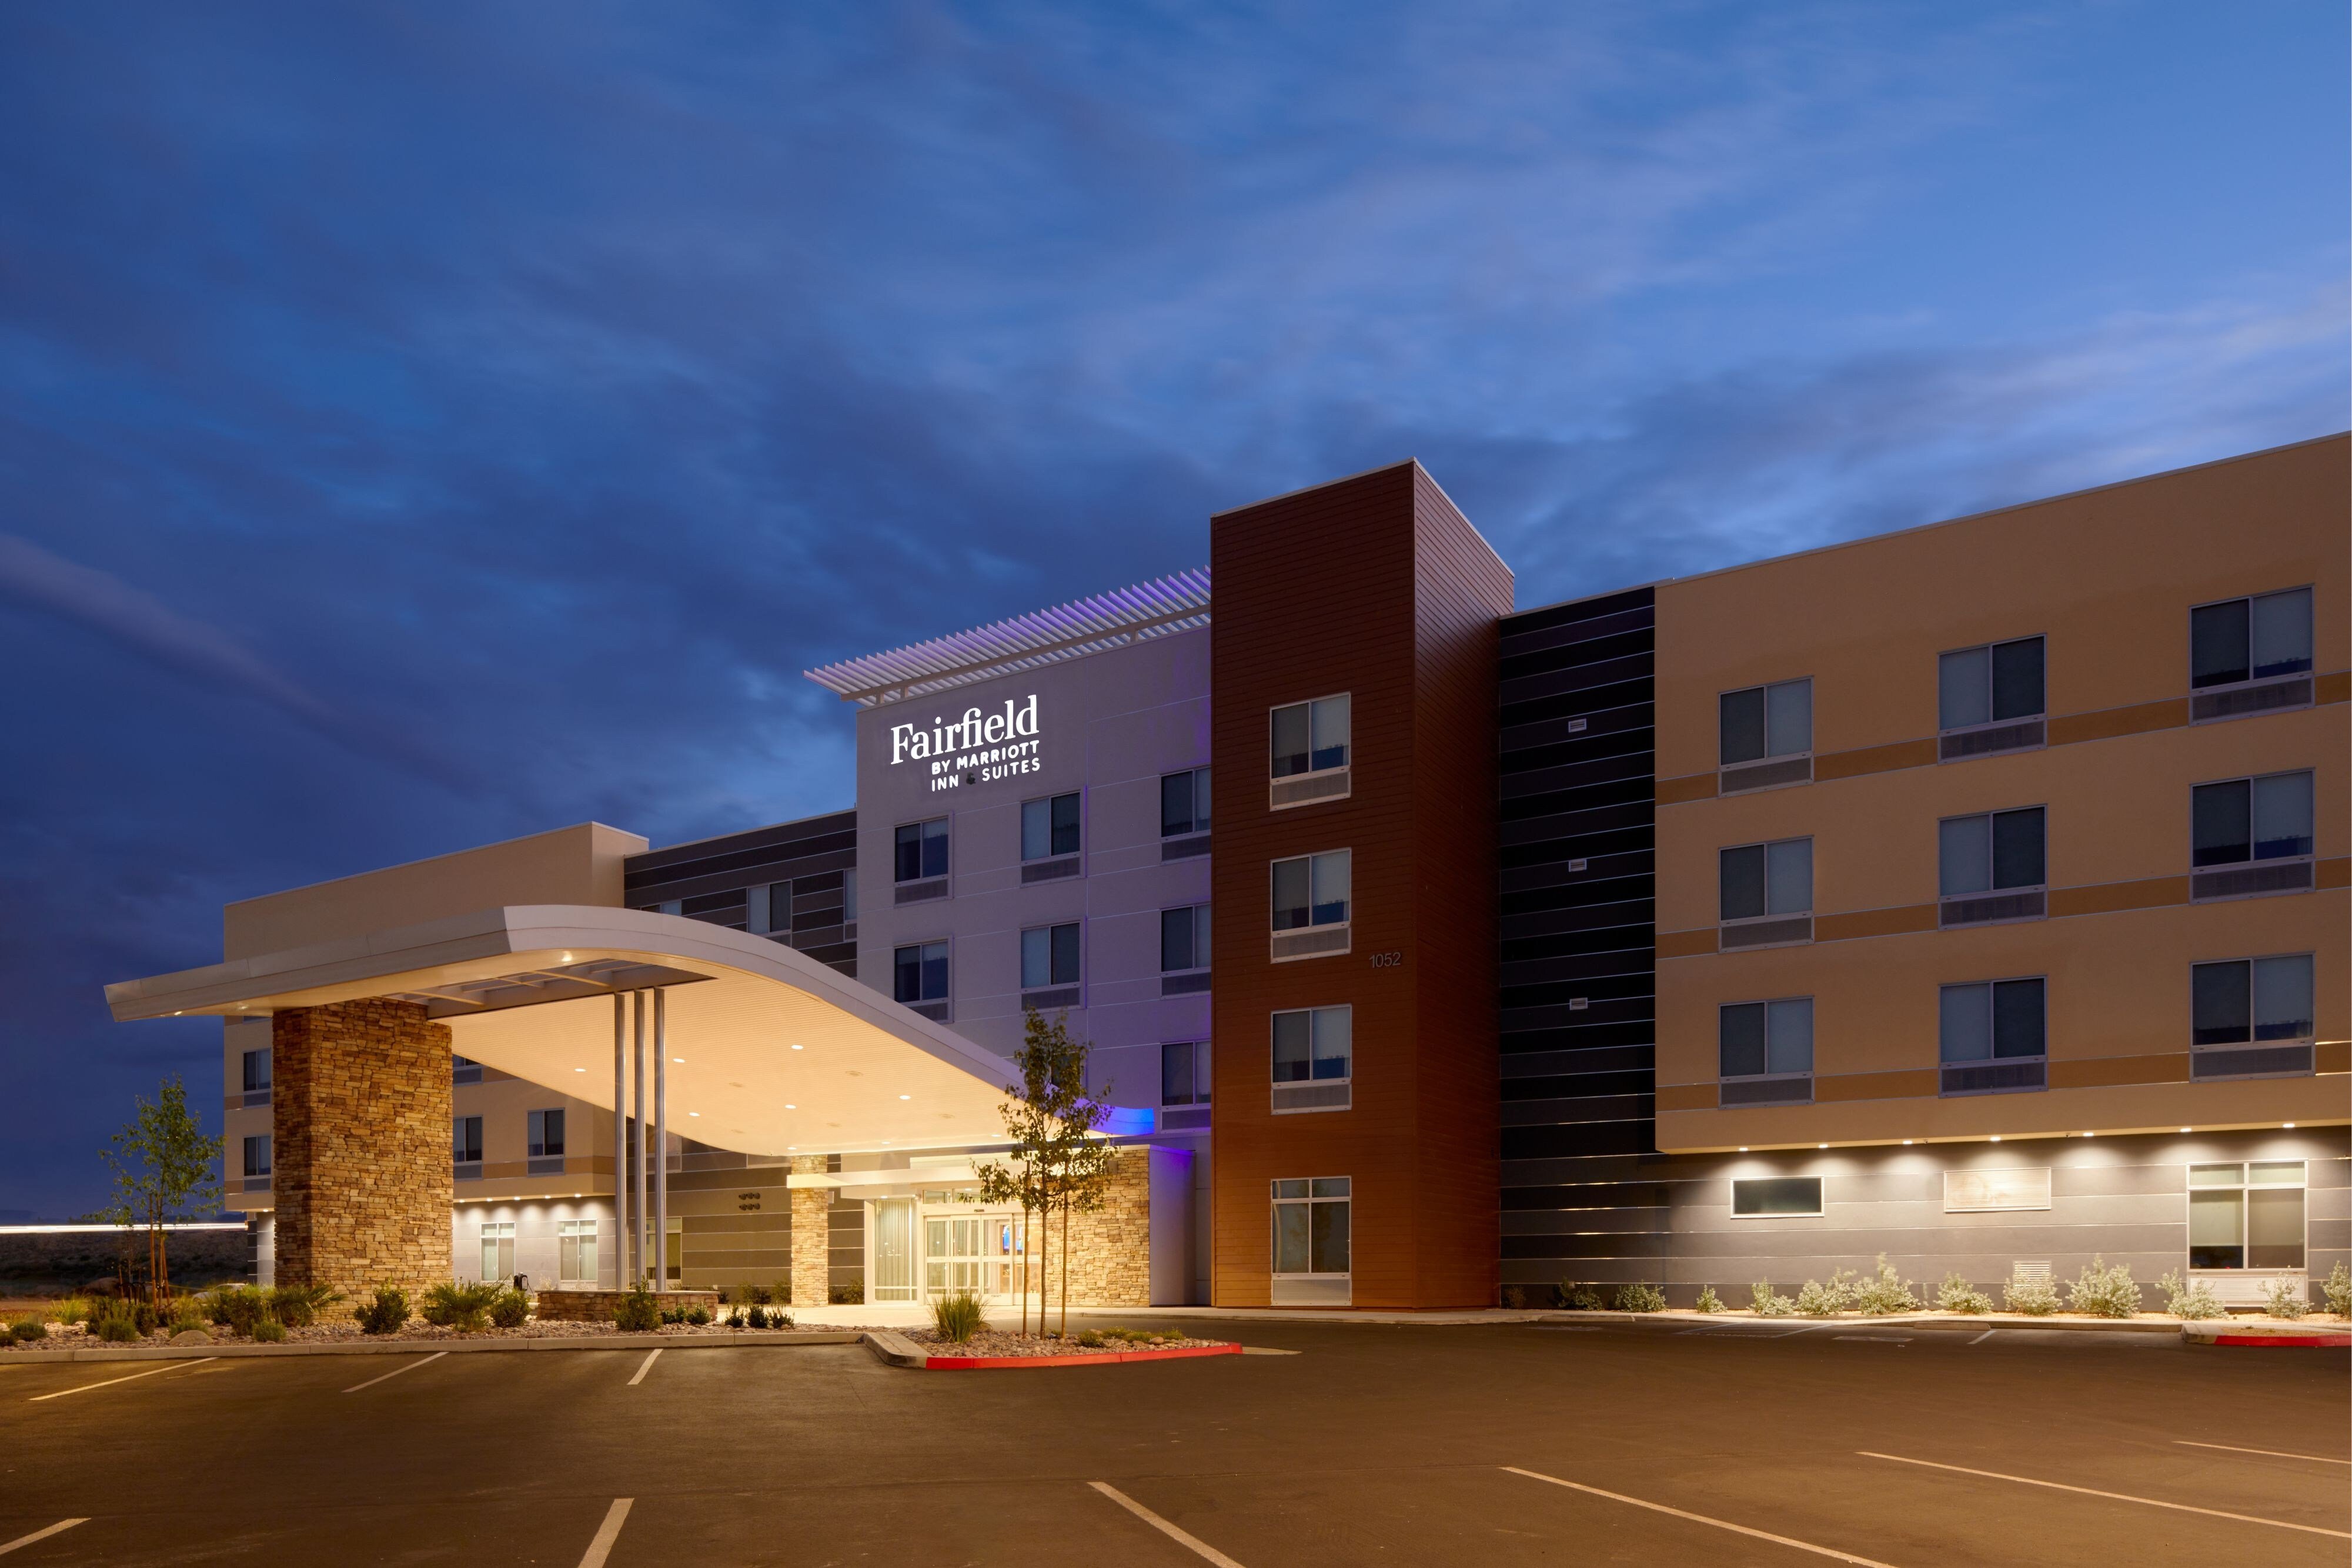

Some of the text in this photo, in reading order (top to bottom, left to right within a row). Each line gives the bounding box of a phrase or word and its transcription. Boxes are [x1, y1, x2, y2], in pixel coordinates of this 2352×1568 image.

[890, 694, 1040, 765] Fairfield
[931, 740, 1040, 775] BY MARRIOTT
[931, 774, 958, 792] INN
[982, 757, 1040, 781] SUITES
[1369, 952, 1401, 968] 1052
